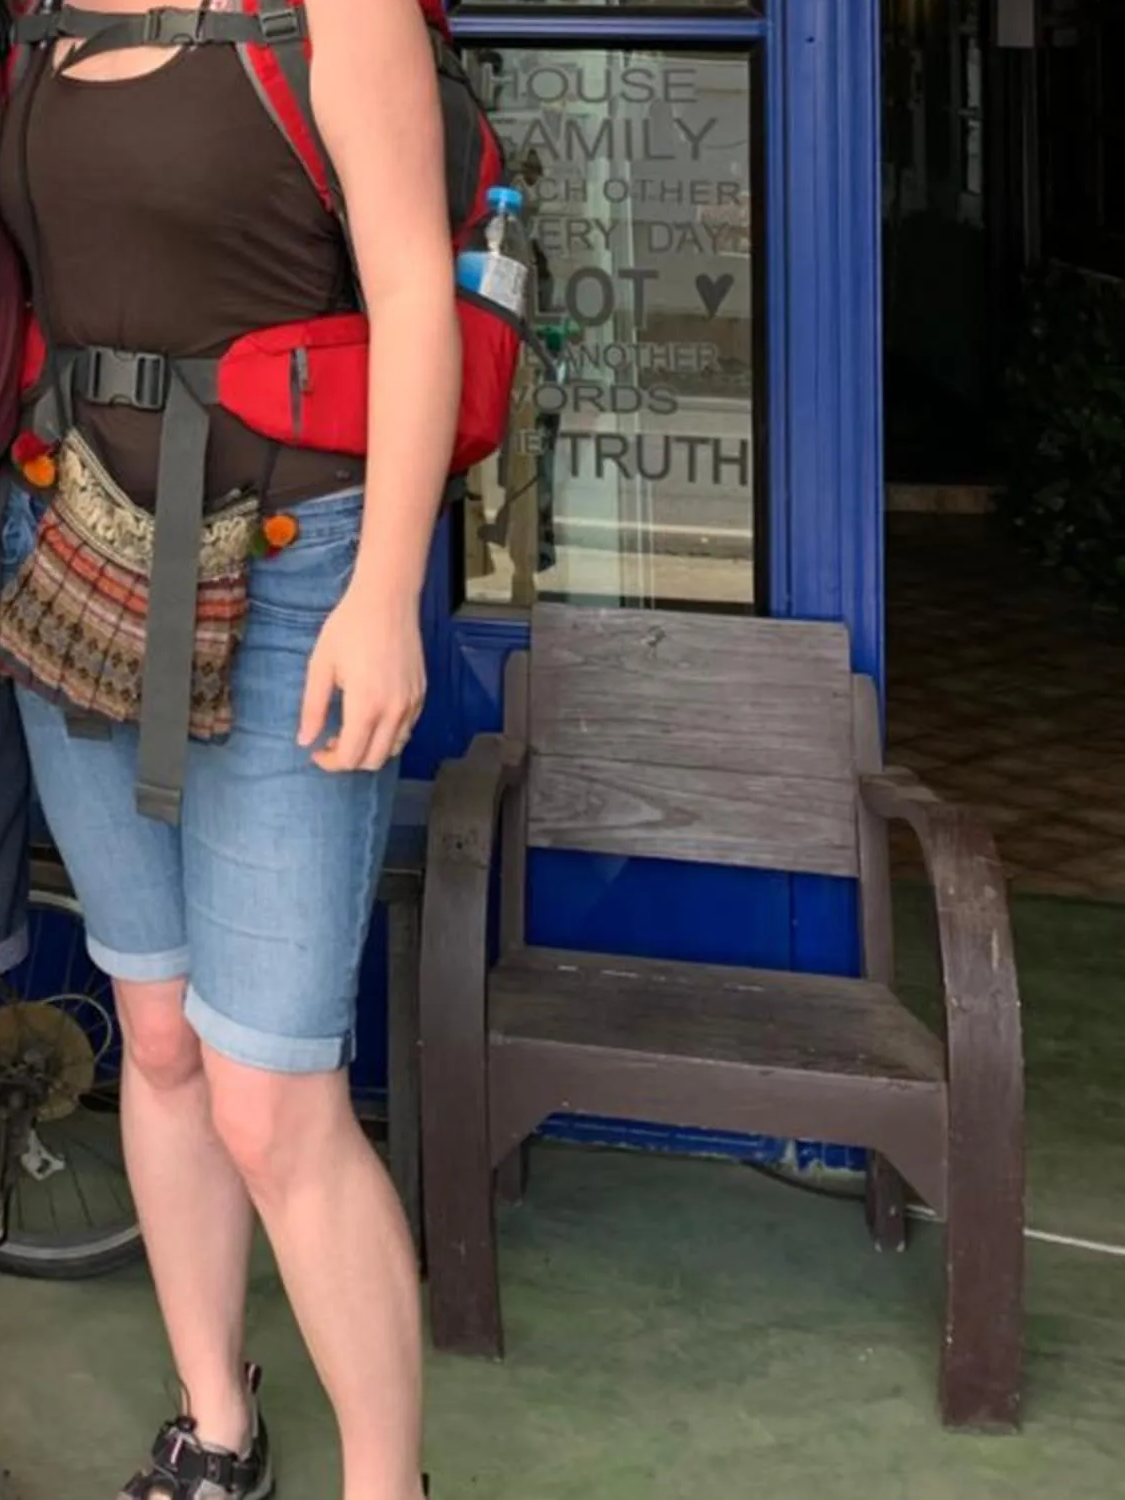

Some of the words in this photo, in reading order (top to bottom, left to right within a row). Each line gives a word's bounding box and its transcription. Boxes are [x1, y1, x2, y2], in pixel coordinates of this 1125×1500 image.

[491, 67, 699, 104] HOUSE
[602, 177, 742, 206] OTHER
[559, 430, 749, 486] TRUTH
